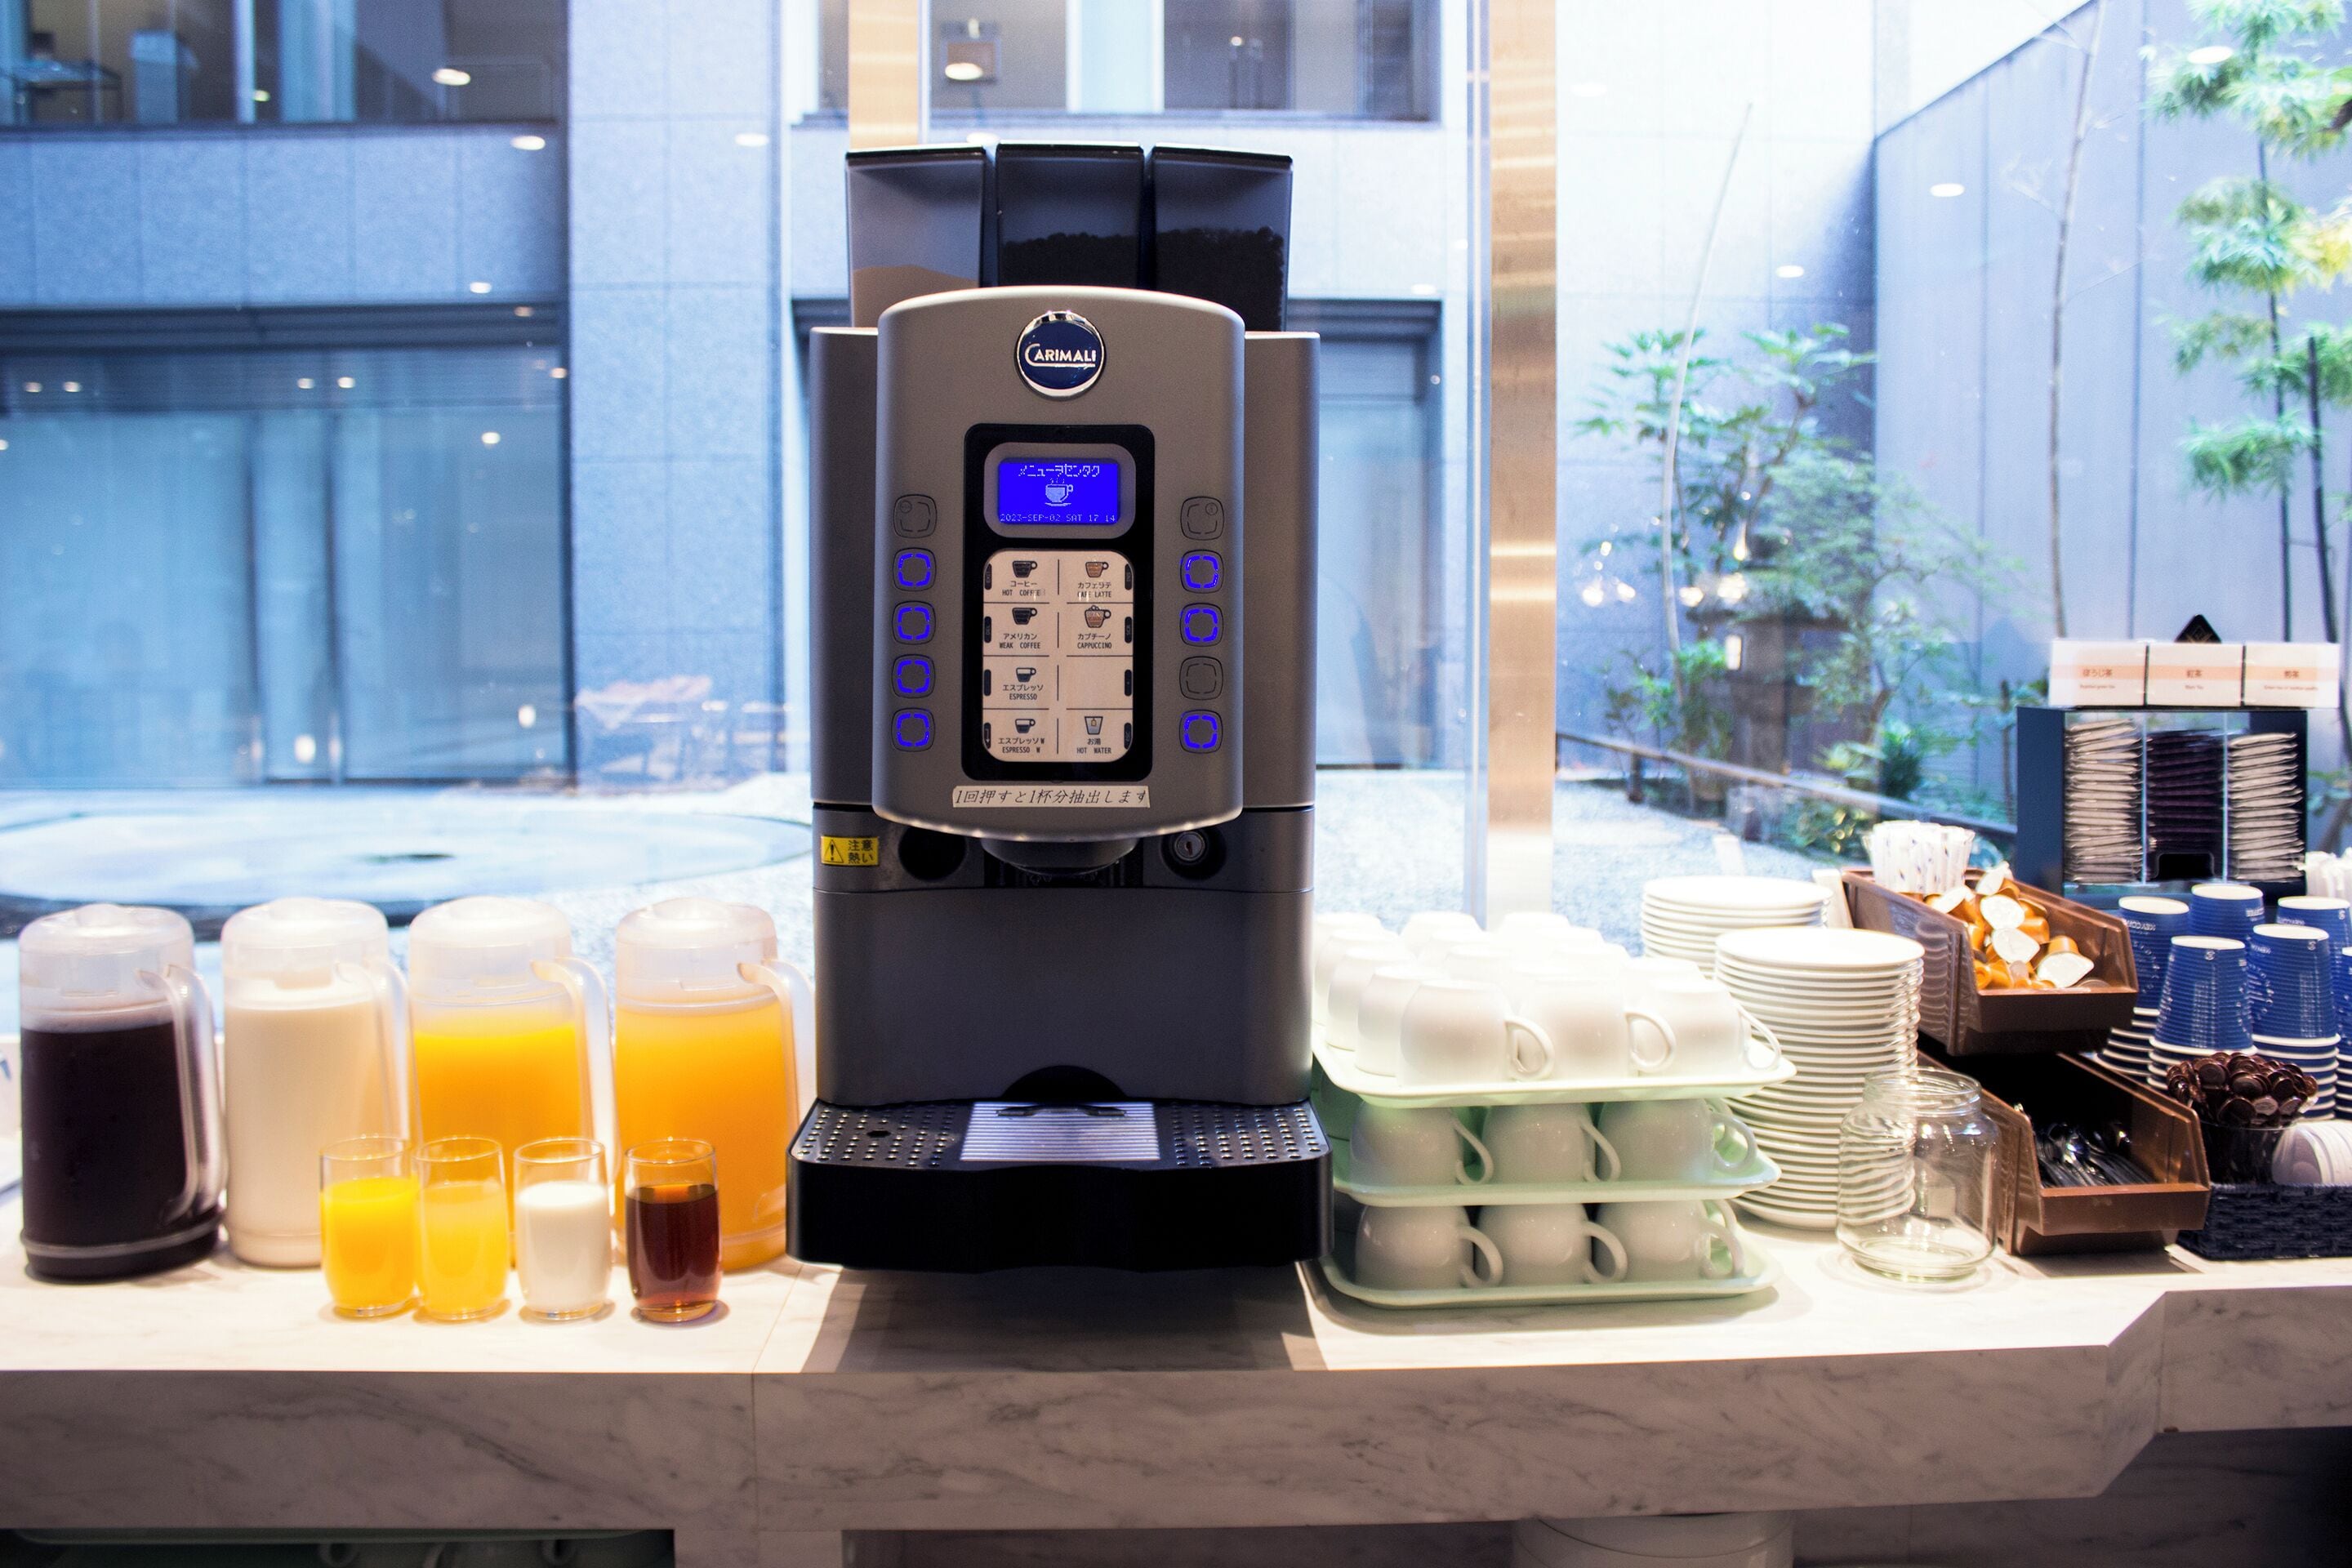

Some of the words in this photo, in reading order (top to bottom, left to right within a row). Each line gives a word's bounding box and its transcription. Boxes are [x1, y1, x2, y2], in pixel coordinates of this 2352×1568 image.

[1025, 343, 1097, 368] CARIMALI
[1000, 514, 1061, 522] 2023-SEP-02
[1066, 514, 1083, 522] SAT
[1002, 684, 1044, 692] エスプレッソ
[955, 789, 1147, 804] 1回押すと1杯分抽出します
[848, 840, 874, 851] 注意
[848, 852, 874, 864] 熱い
